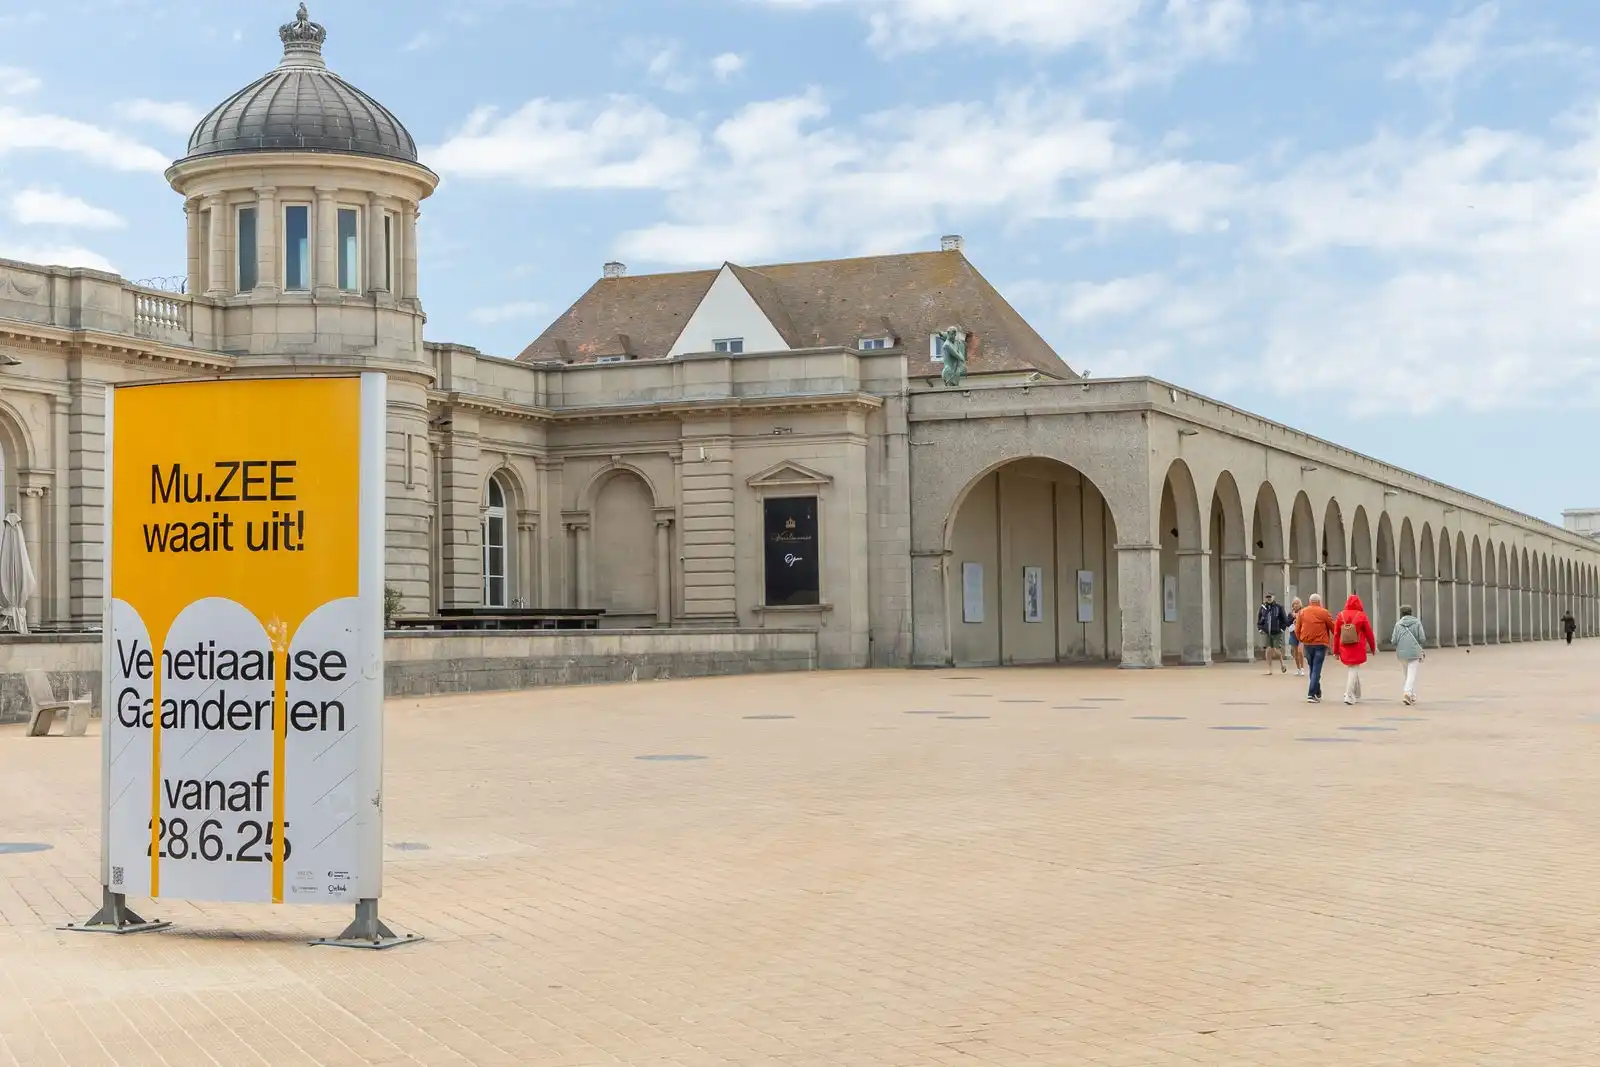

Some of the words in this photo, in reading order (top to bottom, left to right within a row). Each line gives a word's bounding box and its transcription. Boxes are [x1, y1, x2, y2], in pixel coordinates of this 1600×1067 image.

[151, 460, 297, 504] Mu.ZEE
[143, 511, 234, 553] waait
[246, 510, 304, 552] uit!
[116, 639, 347, 682] Venetiaanse
[164, 770, 270, 812] vanaf
[147, 816, 292, 863] 28.6.25
